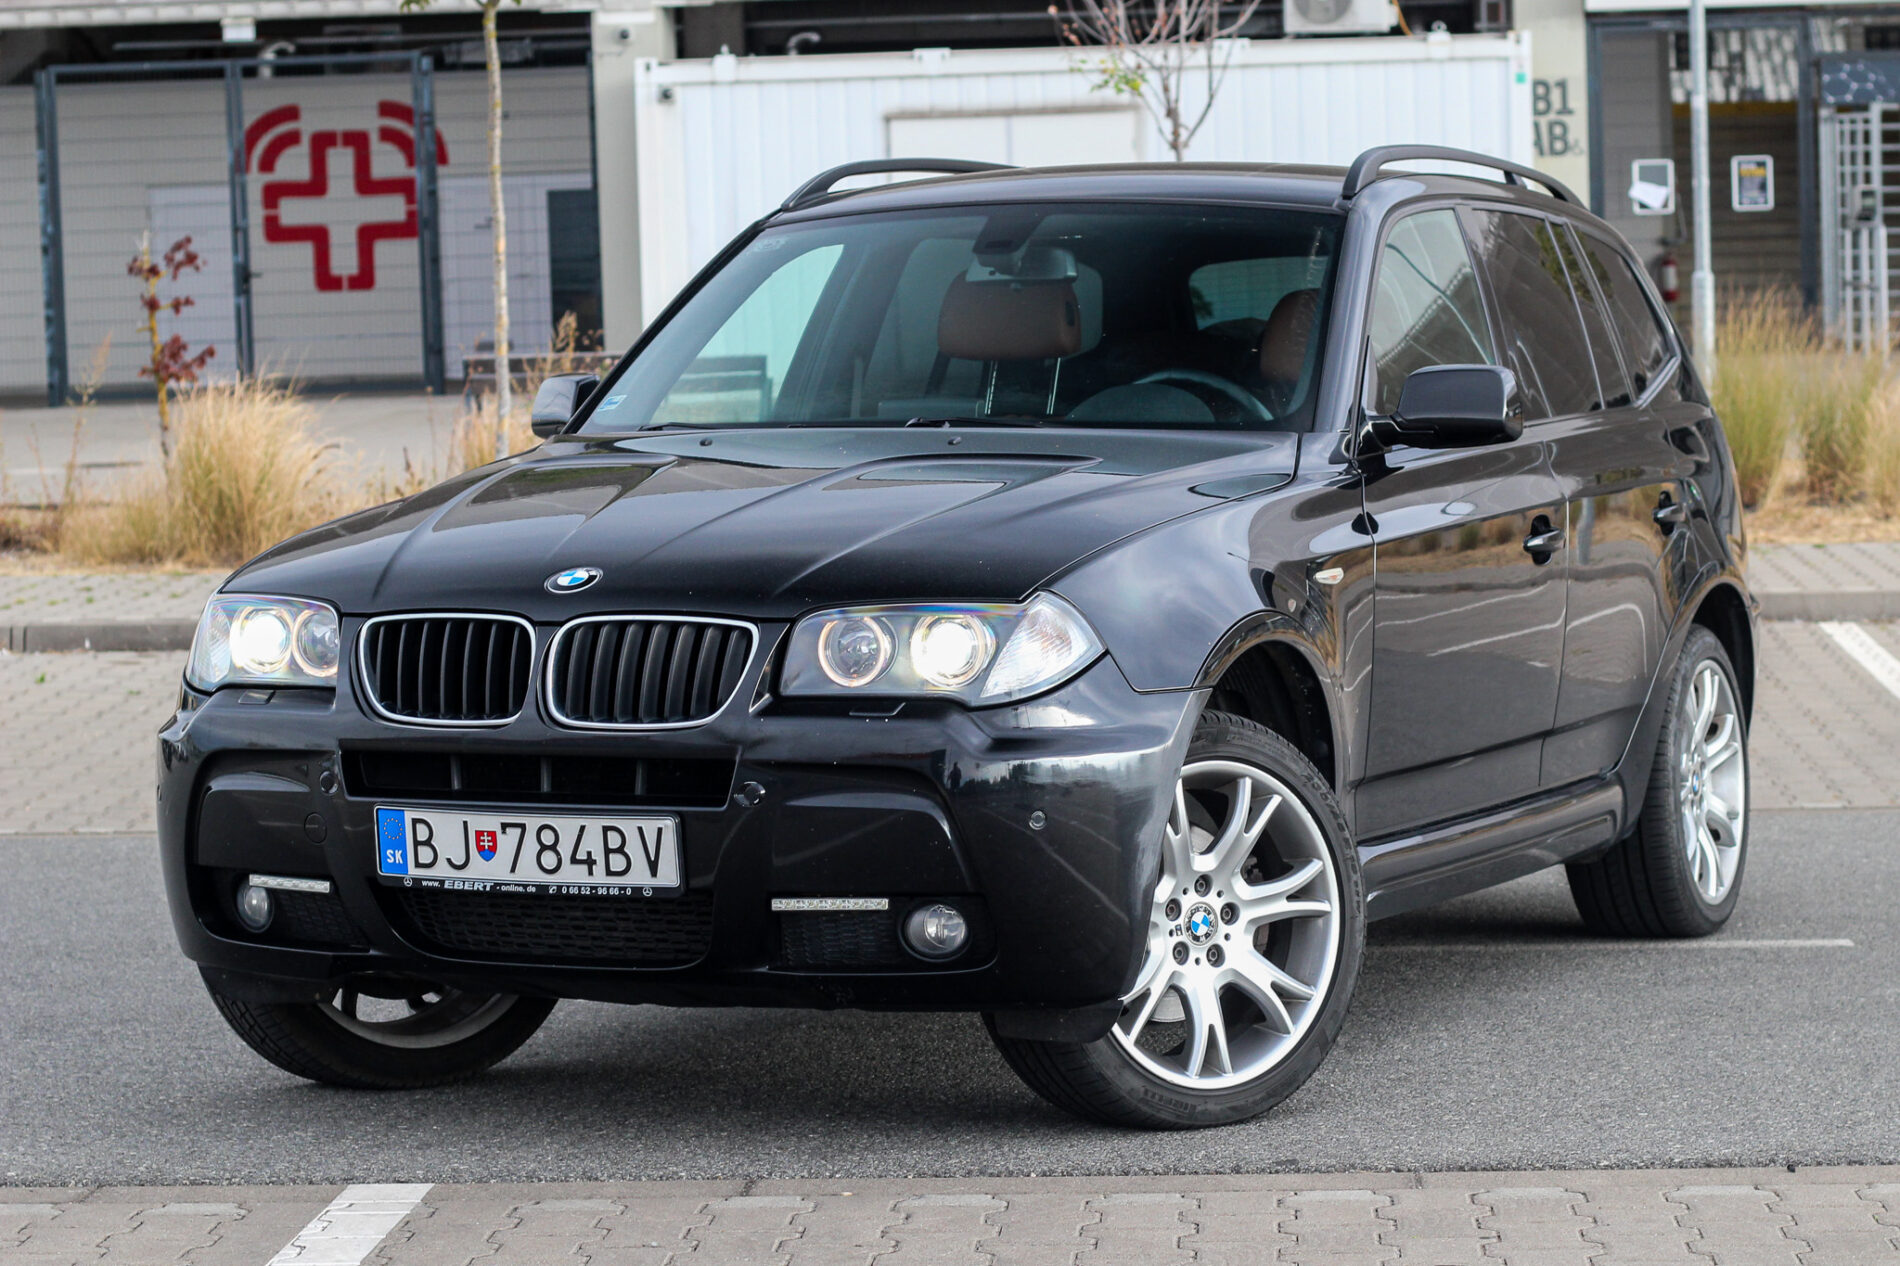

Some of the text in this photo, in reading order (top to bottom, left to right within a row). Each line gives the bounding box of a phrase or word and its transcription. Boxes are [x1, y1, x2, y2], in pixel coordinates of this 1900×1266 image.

[1533, 78, 1575, 116] B1
[386, 849, 404, 865] SK
[411, 817, 665, 878] BJ 784BV
[444, 880, 494, 891] EBERT
